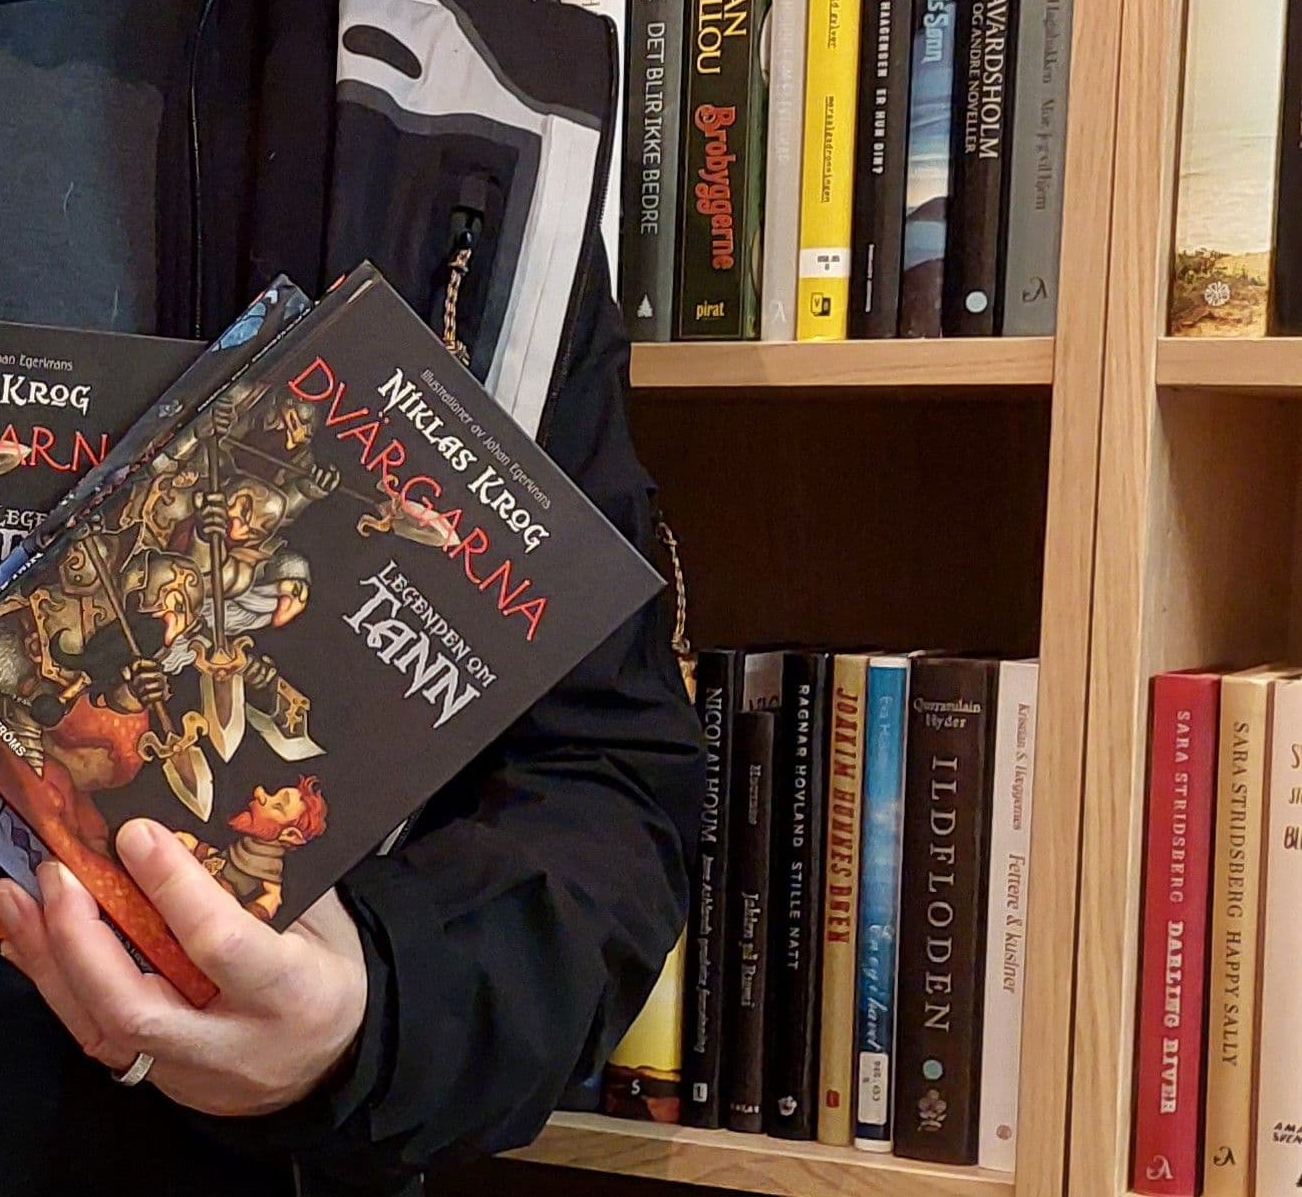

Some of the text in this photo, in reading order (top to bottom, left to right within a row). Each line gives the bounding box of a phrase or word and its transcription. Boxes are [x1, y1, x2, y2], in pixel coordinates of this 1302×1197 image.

[646, 21, 666, 63] DET
[968, 28, 983, 79] ANDRE
[971, 1, 984, 26] OG
[645, 66, 664, 113] BLIR
[964, 79, 980, 155] NOVELLER
[642, 116, 662, 165] IKKE
[640, 168, 660, 235] BEDRE
[694, 103, 737, 273] Brobyggerne
[695, 298, 726, 321] pirat
[287, 355, 551, 642] DVÄRGARNA
[467, 463, 550, 555] KROG
[470, 421, 487, 439] av
[483, 431, 512, 466] Johan
[509, 460, 552, 511] Egerkrans
[341, 574, 482, 730] TANN
[377, 559, 498, 689] LEGENDEN OM
[924, 712, 968, 731] Hyder
[786, 684, 810, 971] RAGNAR HOVLAND STILLE NATT
[921, 755, 959, 1033] ILDFLODEN
[1159, 709, 1192, 1115] SARA STRIDSBERG DARLING RIVER
[1220, 720, 1250, 1069] SARA STRIDSBERG HAPPY SALLY
